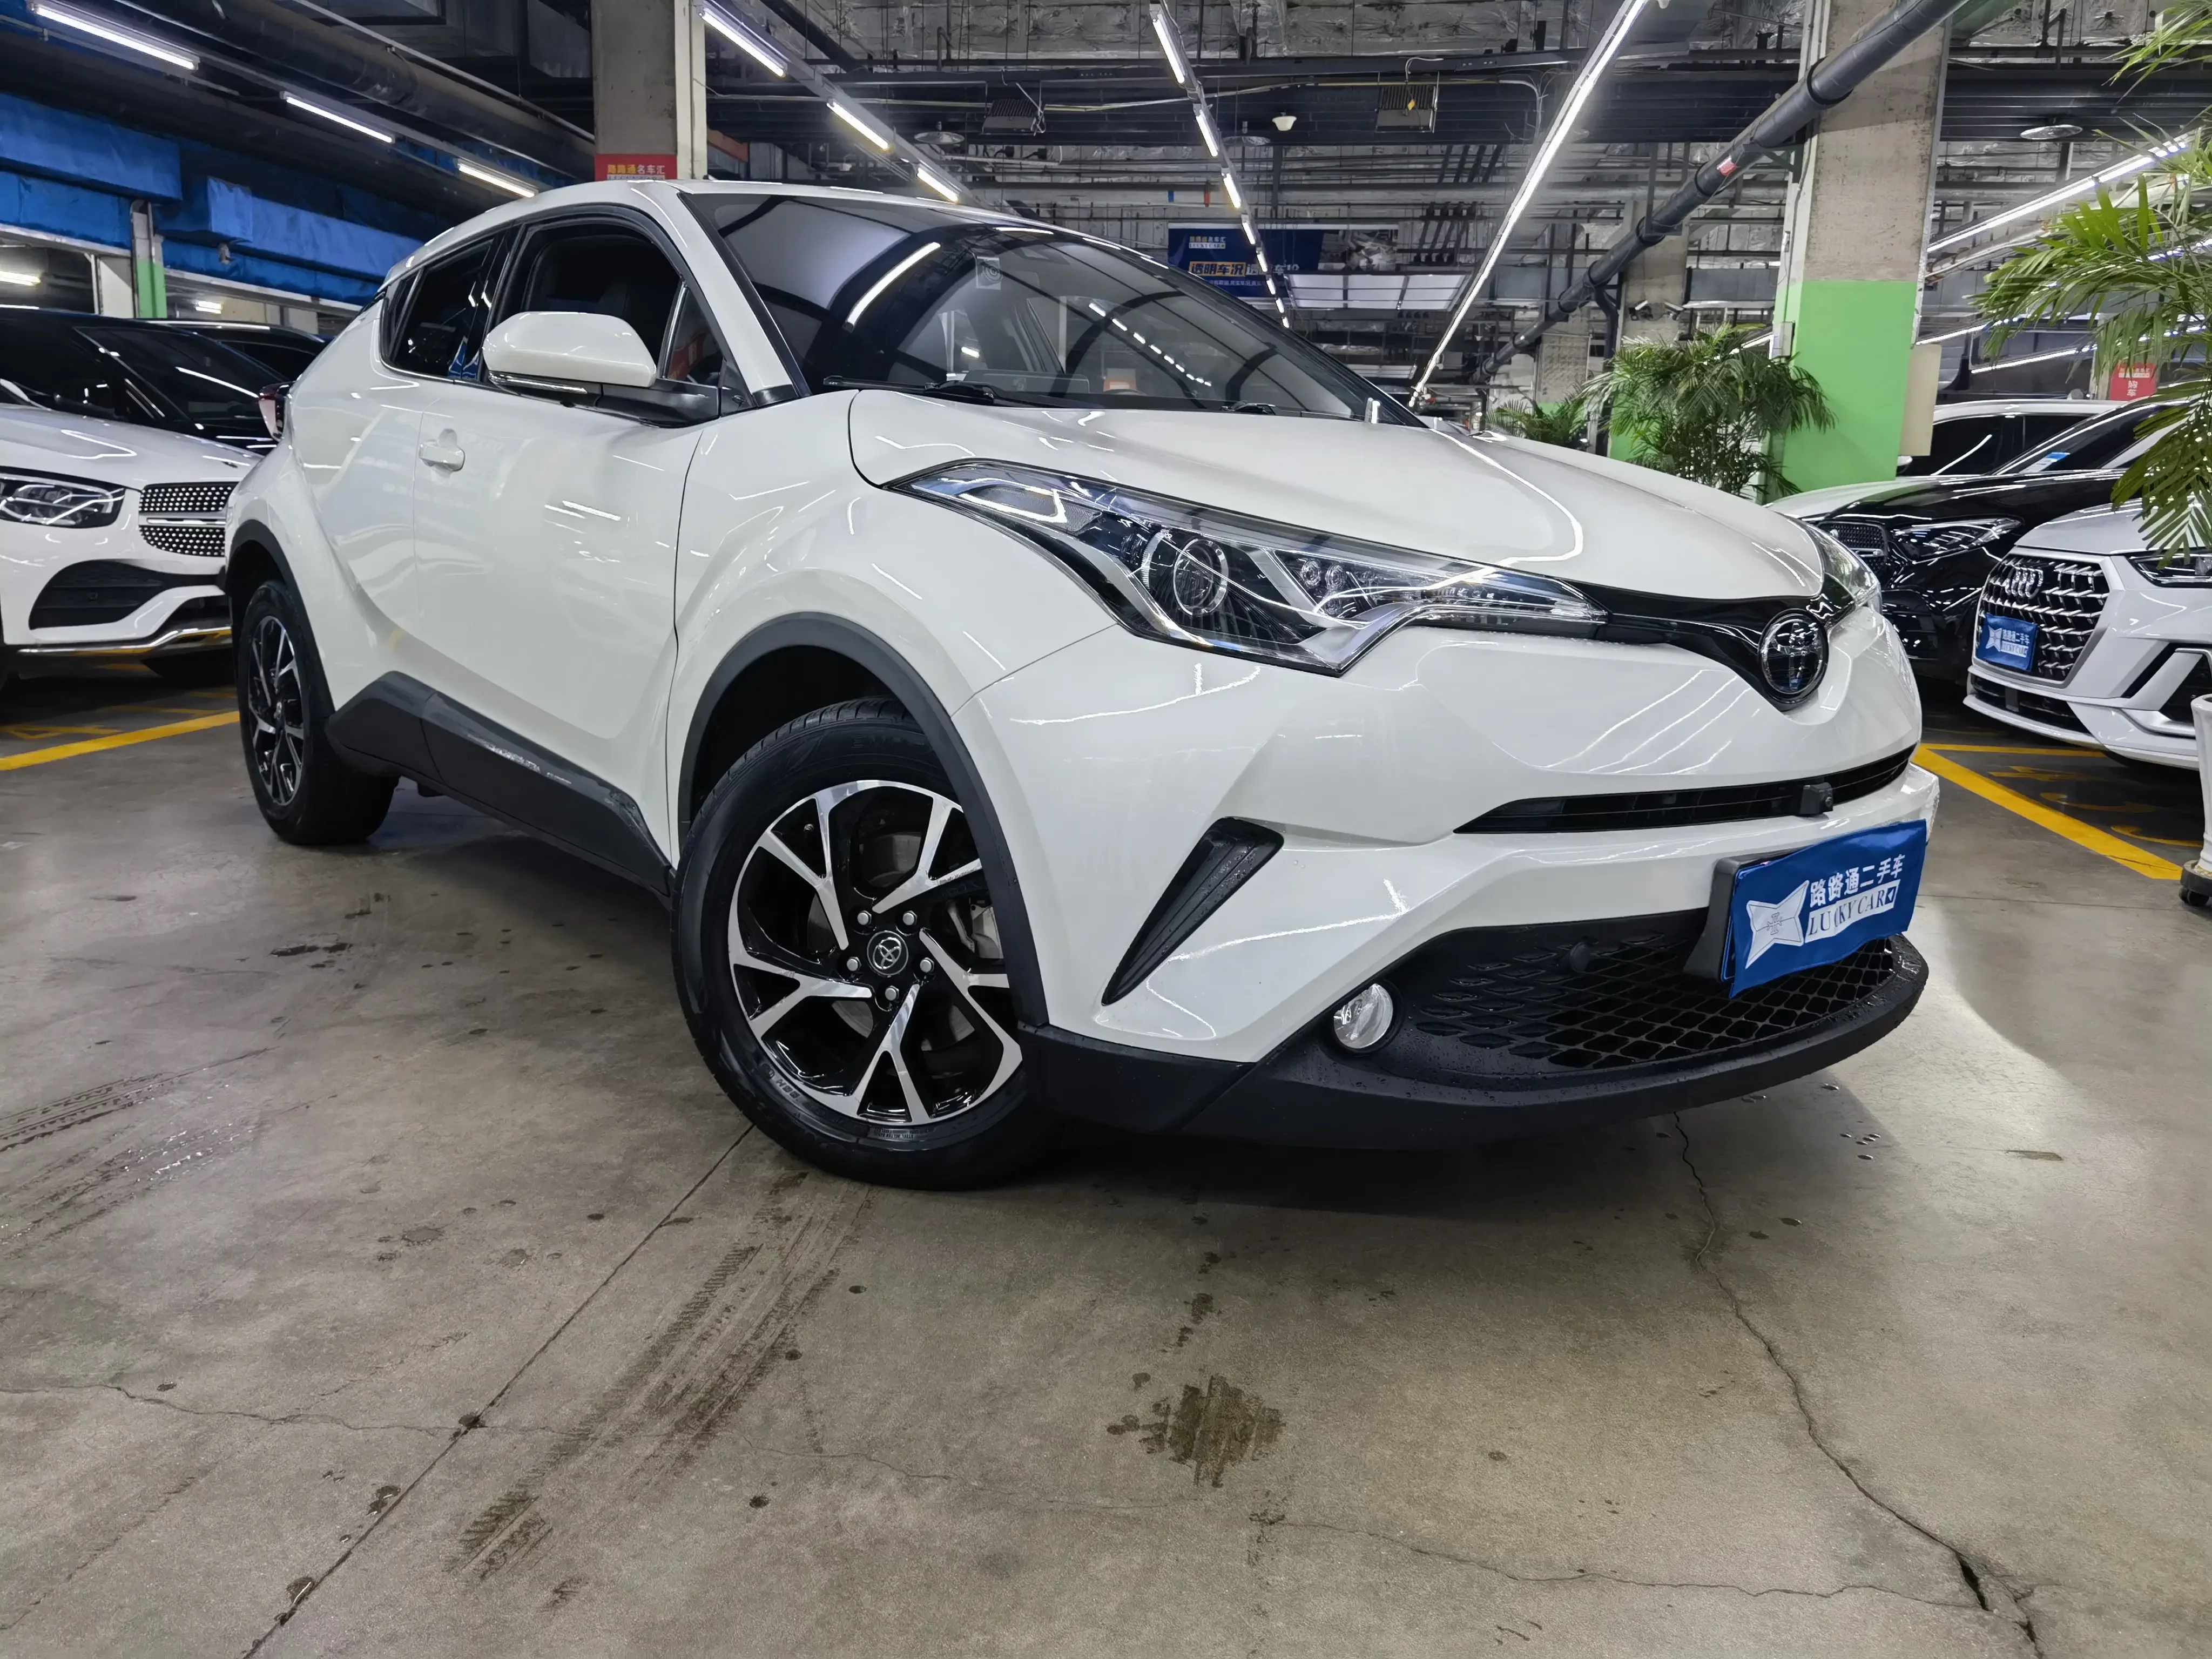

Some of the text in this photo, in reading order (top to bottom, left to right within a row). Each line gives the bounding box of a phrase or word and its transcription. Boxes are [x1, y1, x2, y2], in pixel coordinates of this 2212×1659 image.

[1192, 263, 1243, 275] 透明车况
[1810, 854, 1905, 908] 路路通二手车
[1808, 889, 1885, 936] LUCKY CAR
